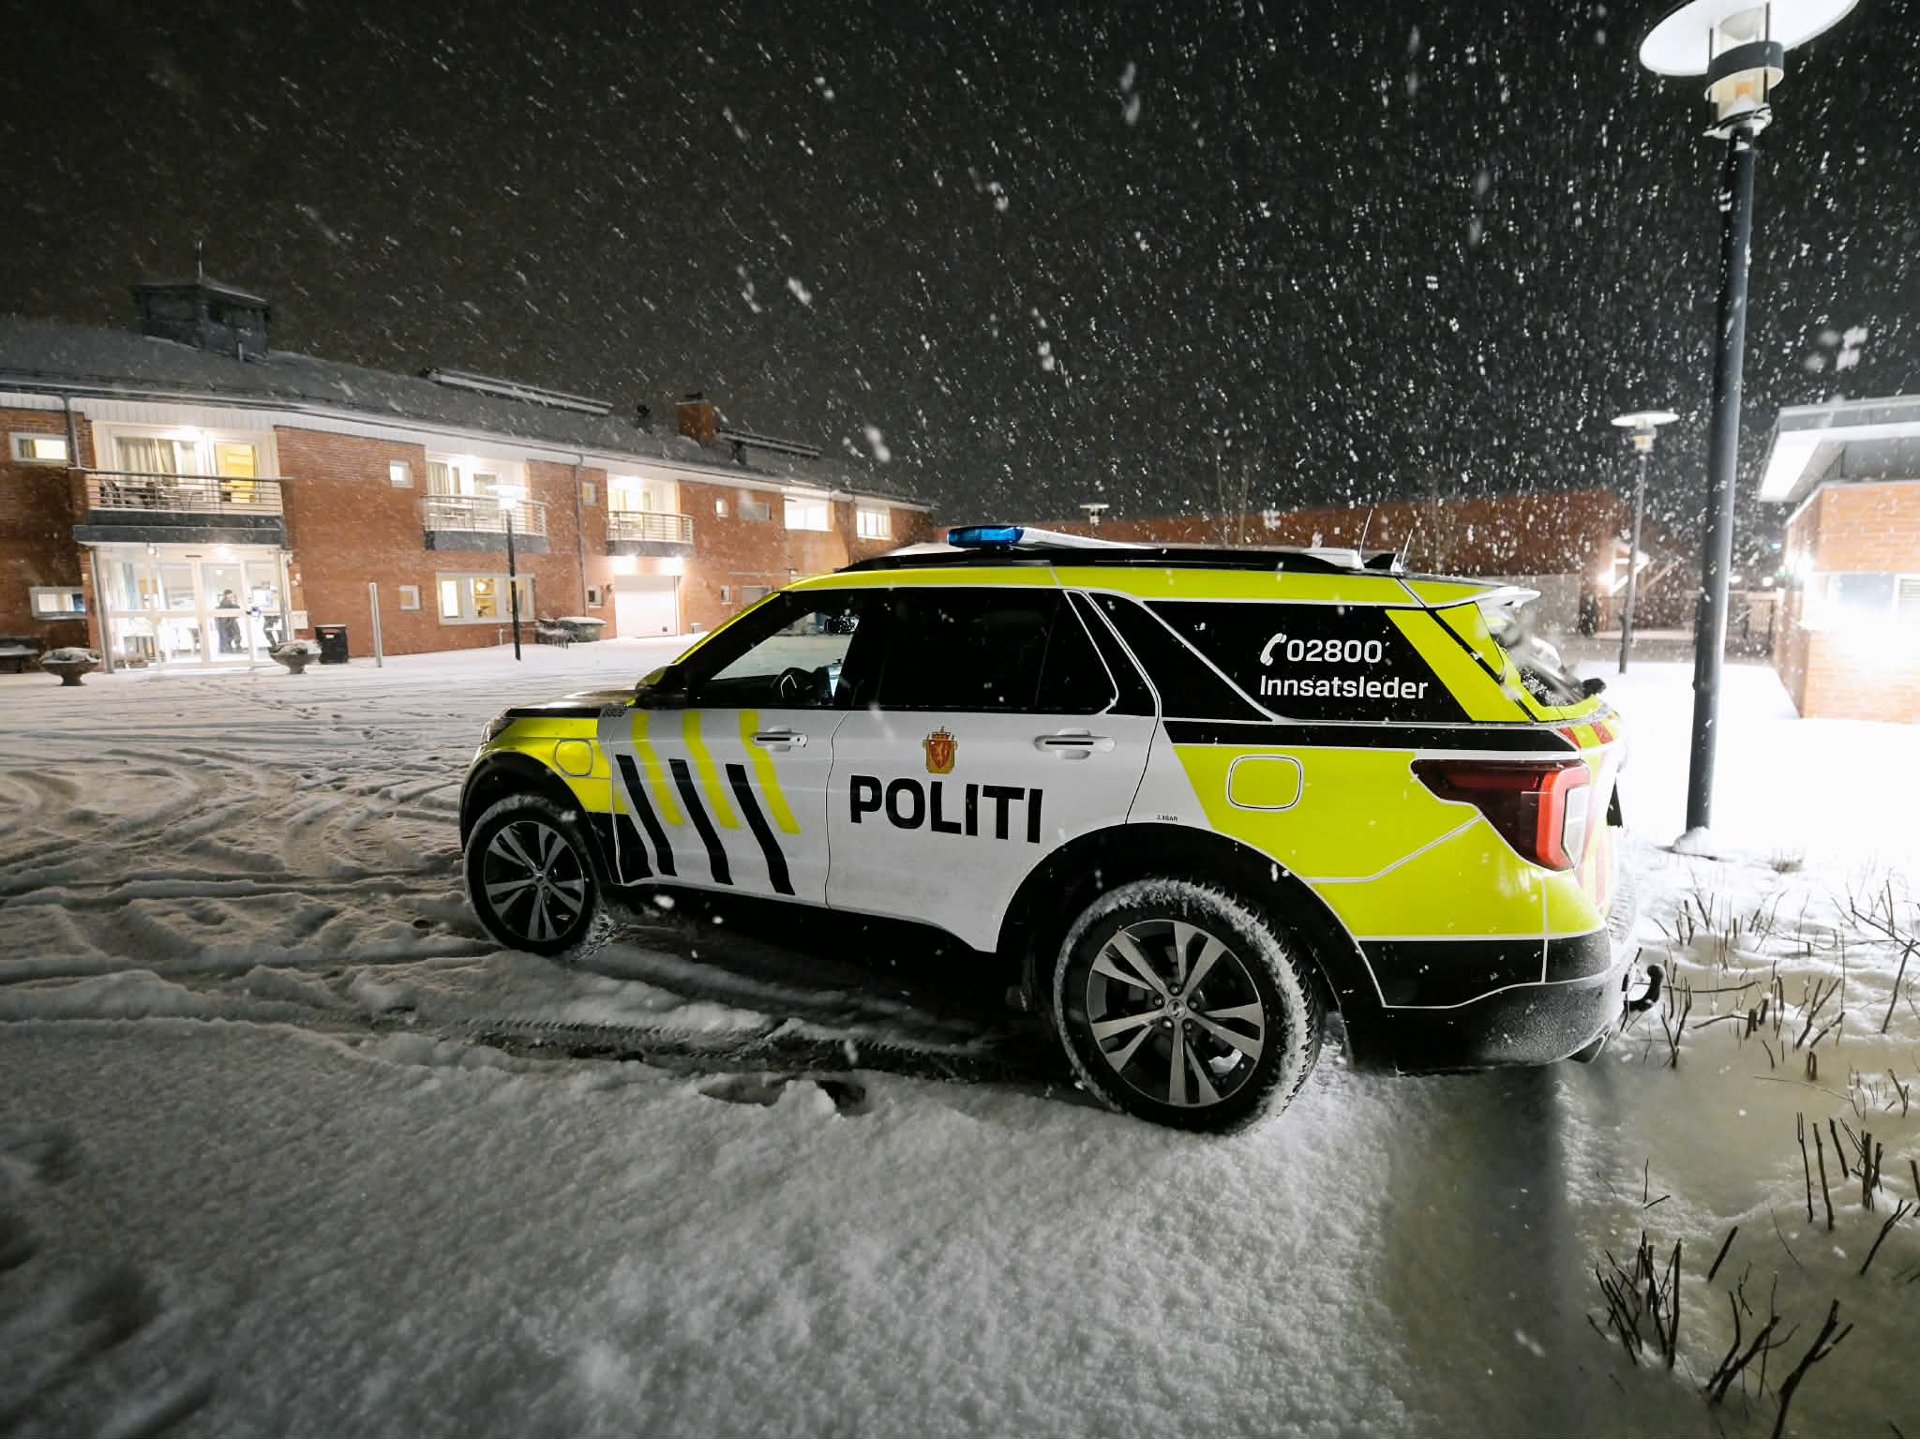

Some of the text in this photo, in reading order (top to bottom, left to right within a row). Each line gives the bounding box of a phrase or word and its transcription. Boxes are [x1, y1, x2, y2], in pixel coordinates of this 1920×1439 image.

[1286, 639, 1383, 663] 02800
[1259, 675, 1429, 699] Innsatsleder
[850, 774, 1043, 844] POLITI
